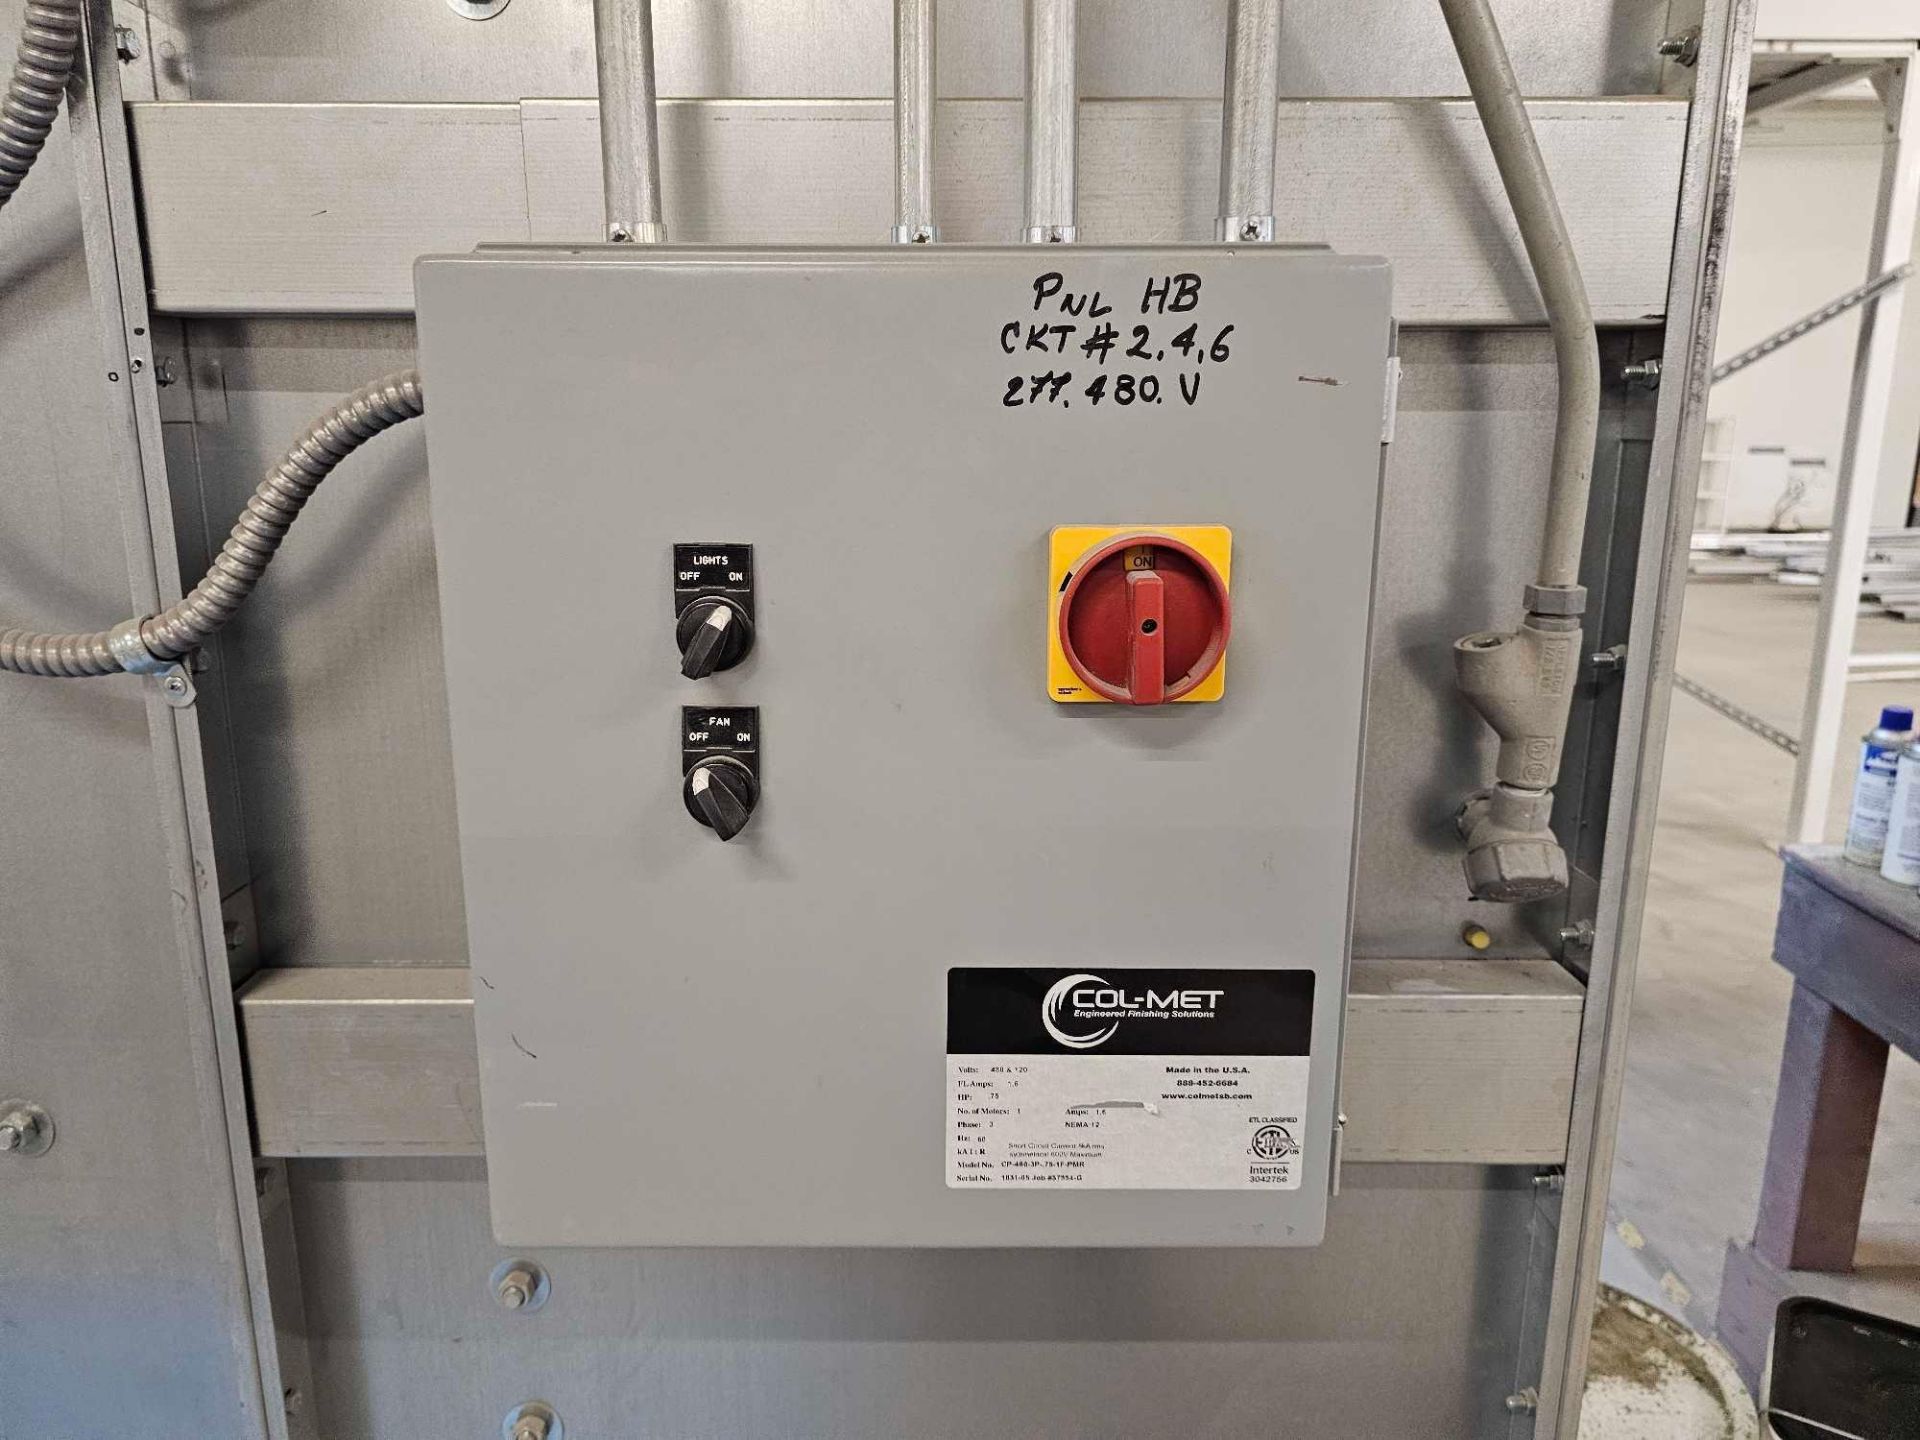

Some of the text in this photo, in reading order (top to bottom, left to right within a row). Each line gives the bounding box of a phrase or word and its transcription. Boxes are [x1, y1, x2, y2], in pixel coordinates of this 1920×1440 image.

[1141, 273, 1202, 314] HB
[1000, 321, 1076, 354] CKT
[1179, 372, 1200, 406] V
[693, 555, 729, 565] LIGHTS
[1133, 556, 1152, 567] ON
[679, 571, 743, 581] OFF ON
[709, 716, 731, 726] FAN
[689, 732, 751, 742] OFF ON
[1073, 989, 1225, 1009] COL-MET
[1073, 1010, 1215, 1019] Engineered Finishing Solutions
[1166, 1066, 1250, 1074] Made in the U.S.A.
[1161, 1092, 1253, 1100] www.colmetsb.com
[1249, 1166, 1289, 1174] Intertek
